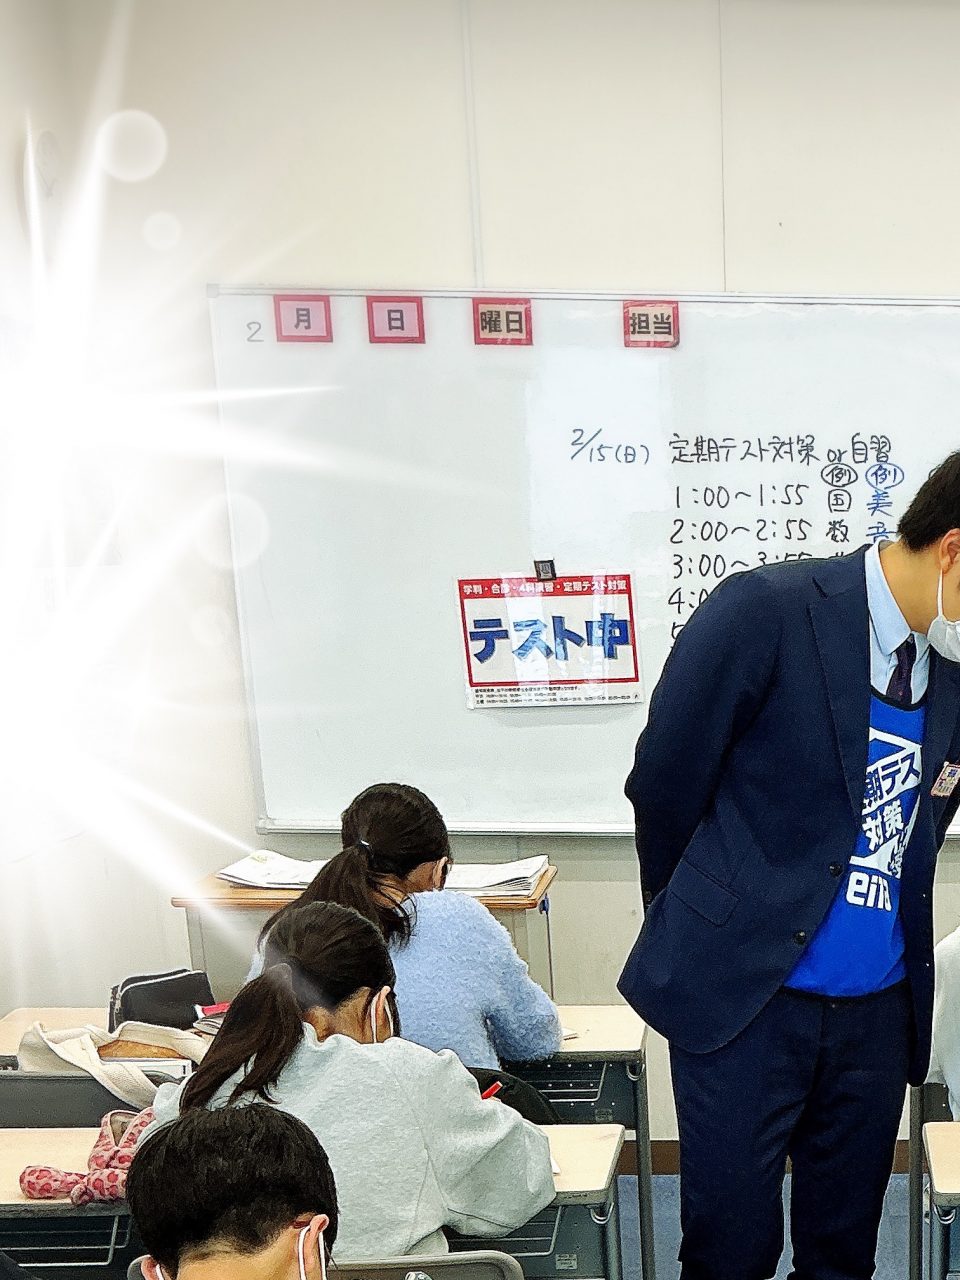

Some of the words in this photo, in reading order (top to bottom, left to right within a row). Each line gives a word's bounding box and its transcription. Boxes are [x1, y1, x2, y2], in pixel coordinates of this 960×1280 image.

[246, 321, 264, 342] 2
[294, 308, 312, 331] 月
[387, 309, 405, 331] 日
[480, 310, 524, 334] 曜日
[629, 312, 673, 336] 担当
[469, 612, 632, 664] テスト中
[862, 800, 904, 852] 対策
